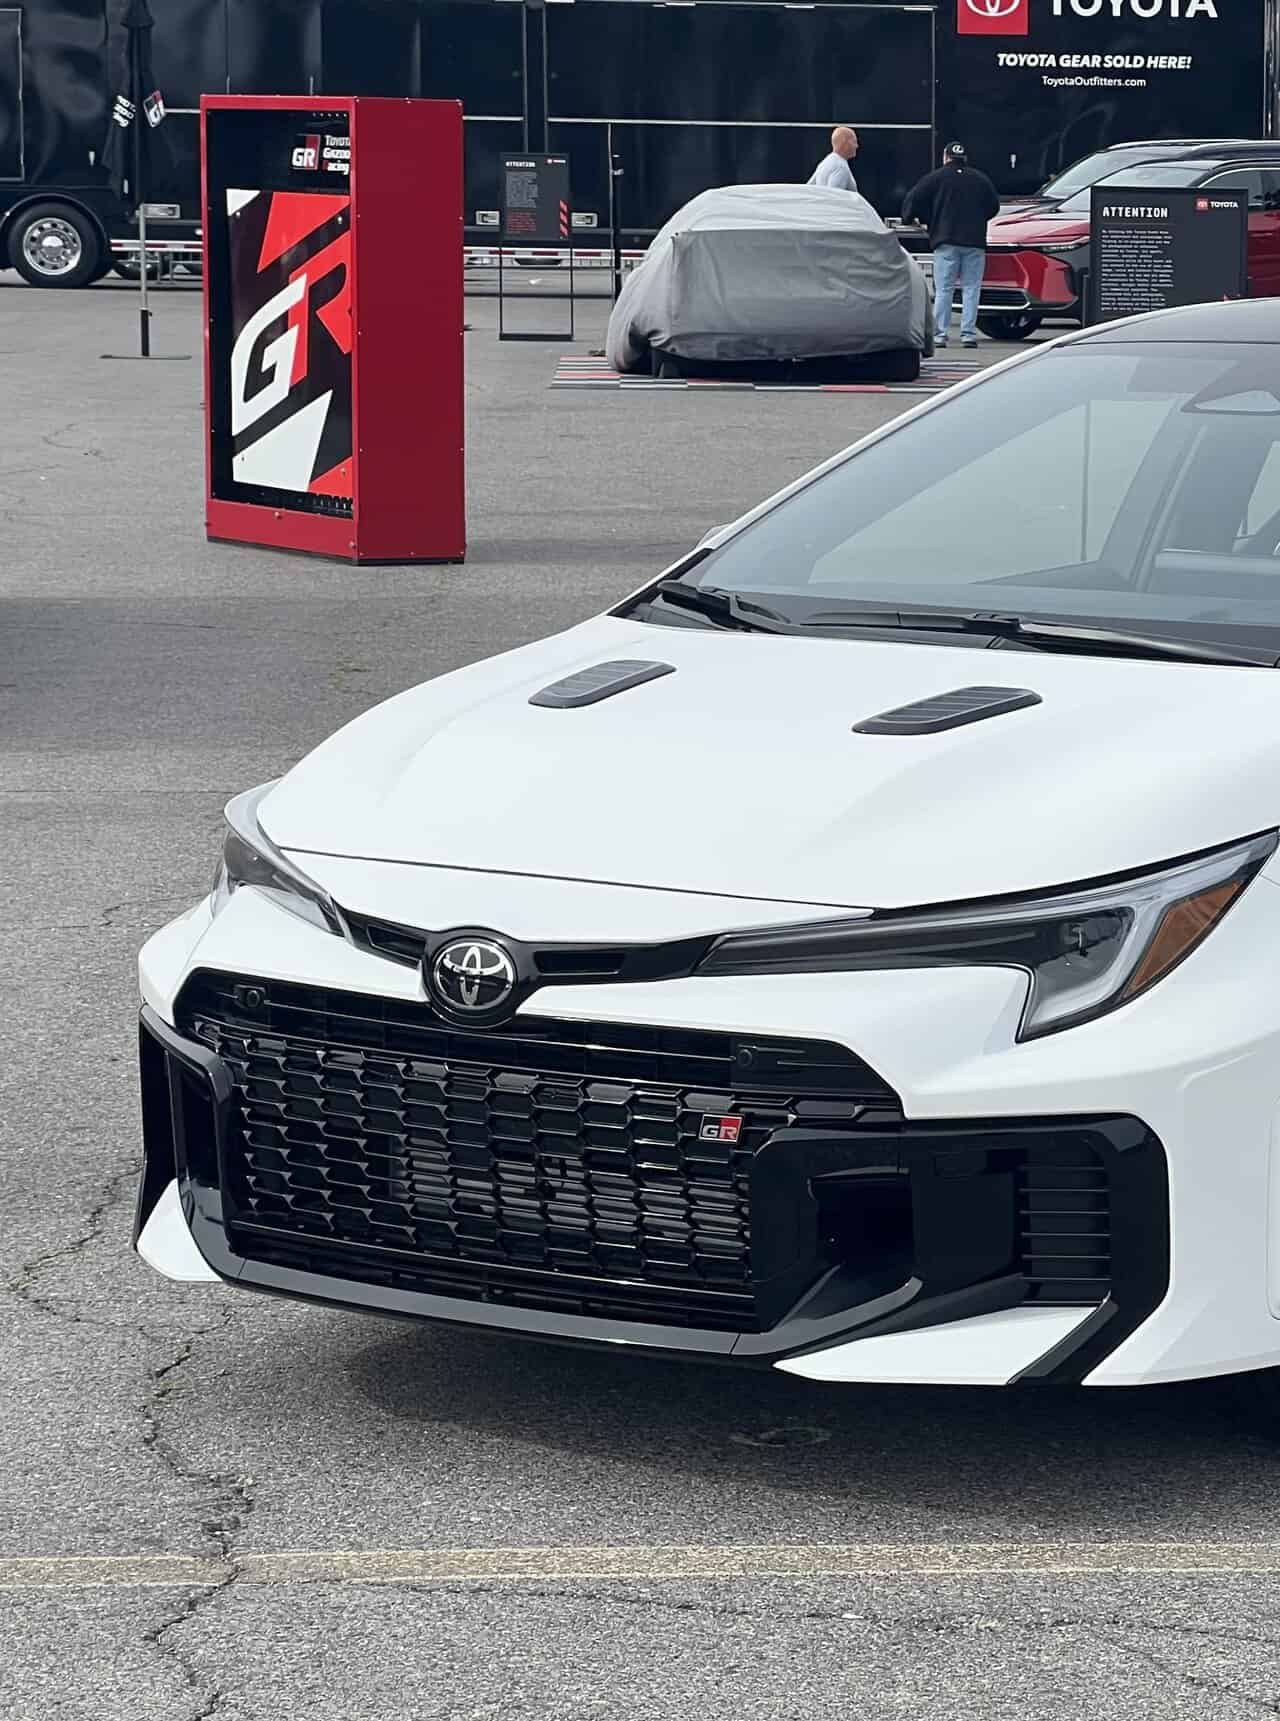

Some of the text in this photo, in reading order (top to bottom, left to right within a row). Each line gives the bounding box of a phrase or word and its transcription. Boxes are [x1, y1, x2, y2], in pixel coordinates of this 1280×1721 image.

[997, 53, 1193, 69] TOYOTA GEAR SOLD HERE!
[1041, 75, 1147, 88] ToyotaOutfitters.com
[292, 147, 316, 168] GR
[1102, 206, 1169, 218] ATTENTION
[1210, 201, 1239, 209] TOYOTA
[231, 230, 352, 437] GR
[702, 1125, 738, 1139] GR
